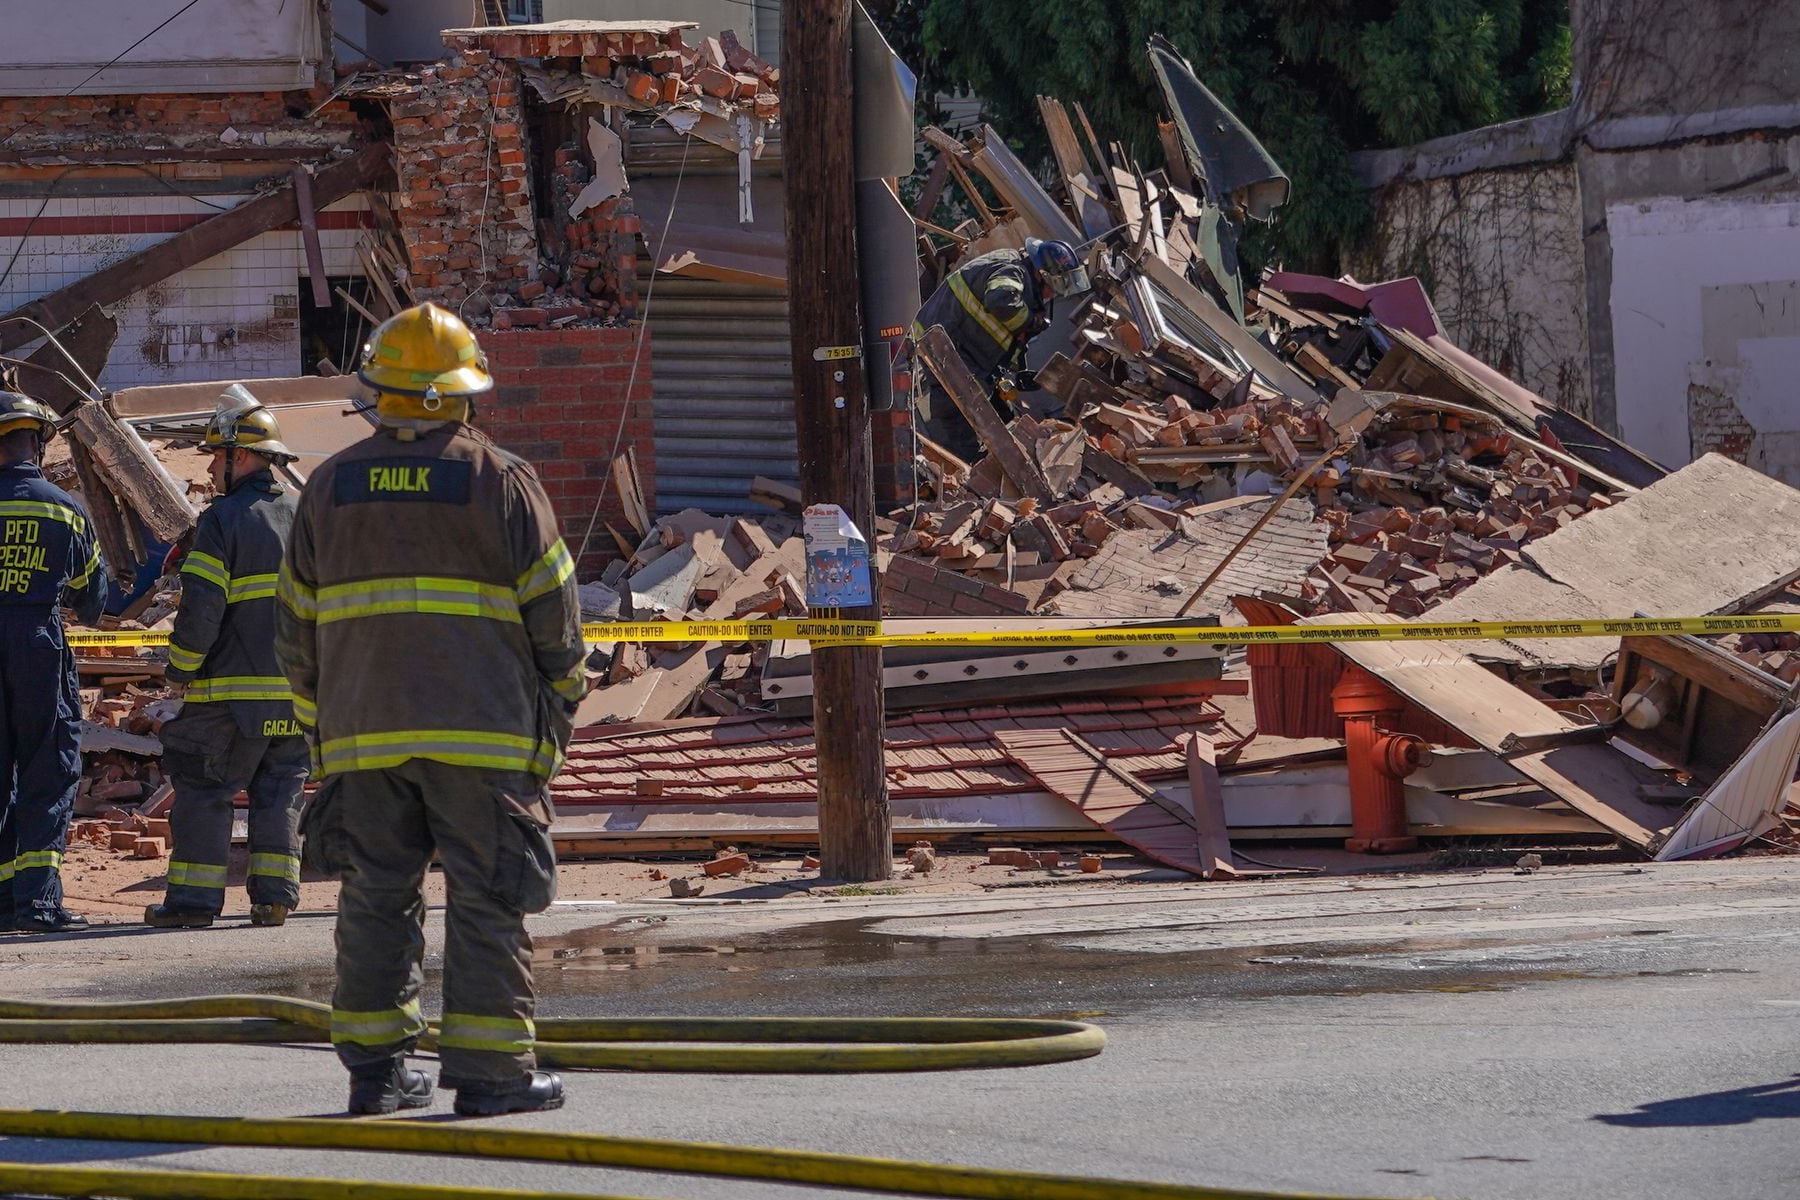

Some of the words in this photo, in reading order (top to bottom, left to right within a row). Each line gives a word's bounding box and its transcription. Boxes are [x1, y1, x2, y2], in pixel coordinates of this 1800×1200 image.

[369, 467, 431, 492] FAULK
[5, 519, 40, 544] PFD
[1503, 625, 1544, 634] CAUTION-DO
[1546, 624, 1559, 634] NOT
[1561, 624, 1583, 634] ENTER
[1604, 623, 1645, 632] CAUTION-DO
[1646, 622, 1659, 632] NOT
[1660, 622, 1684, 631] ENTER
[1703, 620, 1744, 630] CAUTION-DO
[1746, 620, 1759, 628] NOT
[1761, 618, 1783, 628] ENTER
[625, 626, 639, 638] NOT
[640, 626, 664, 637] ENTER
[688, 626, 729, 636] CAUTION-DO
[731, 625, 748, 636] NOT
[749, 624, 773, 636] ENTER
[796, 624, 840, 636] CAUTION-DO
[841, 625, 855, 636] NOT
[856, 626, 876, 637] ENTER
[1300, 630, 1341, 638] CAUTION-DO
[1342, 630, 1356, 638] NOT
[1357, 629, 1381, 638] ENTER
[1401, 628, 1443, 637] CAUTION-DO
[1444, 628, 1458, 636] NOT
[1459, 627, 1482, 636] ENTER
[93, 636, 117, 644] ENTER
[141, 634, 169, 644] CAUTIO
[1198, 632, 1240, 640] CAUTION-DO
[1255, 632, 1279, 640] ENTER
[263, 719, 303, 737] GAGLIA
